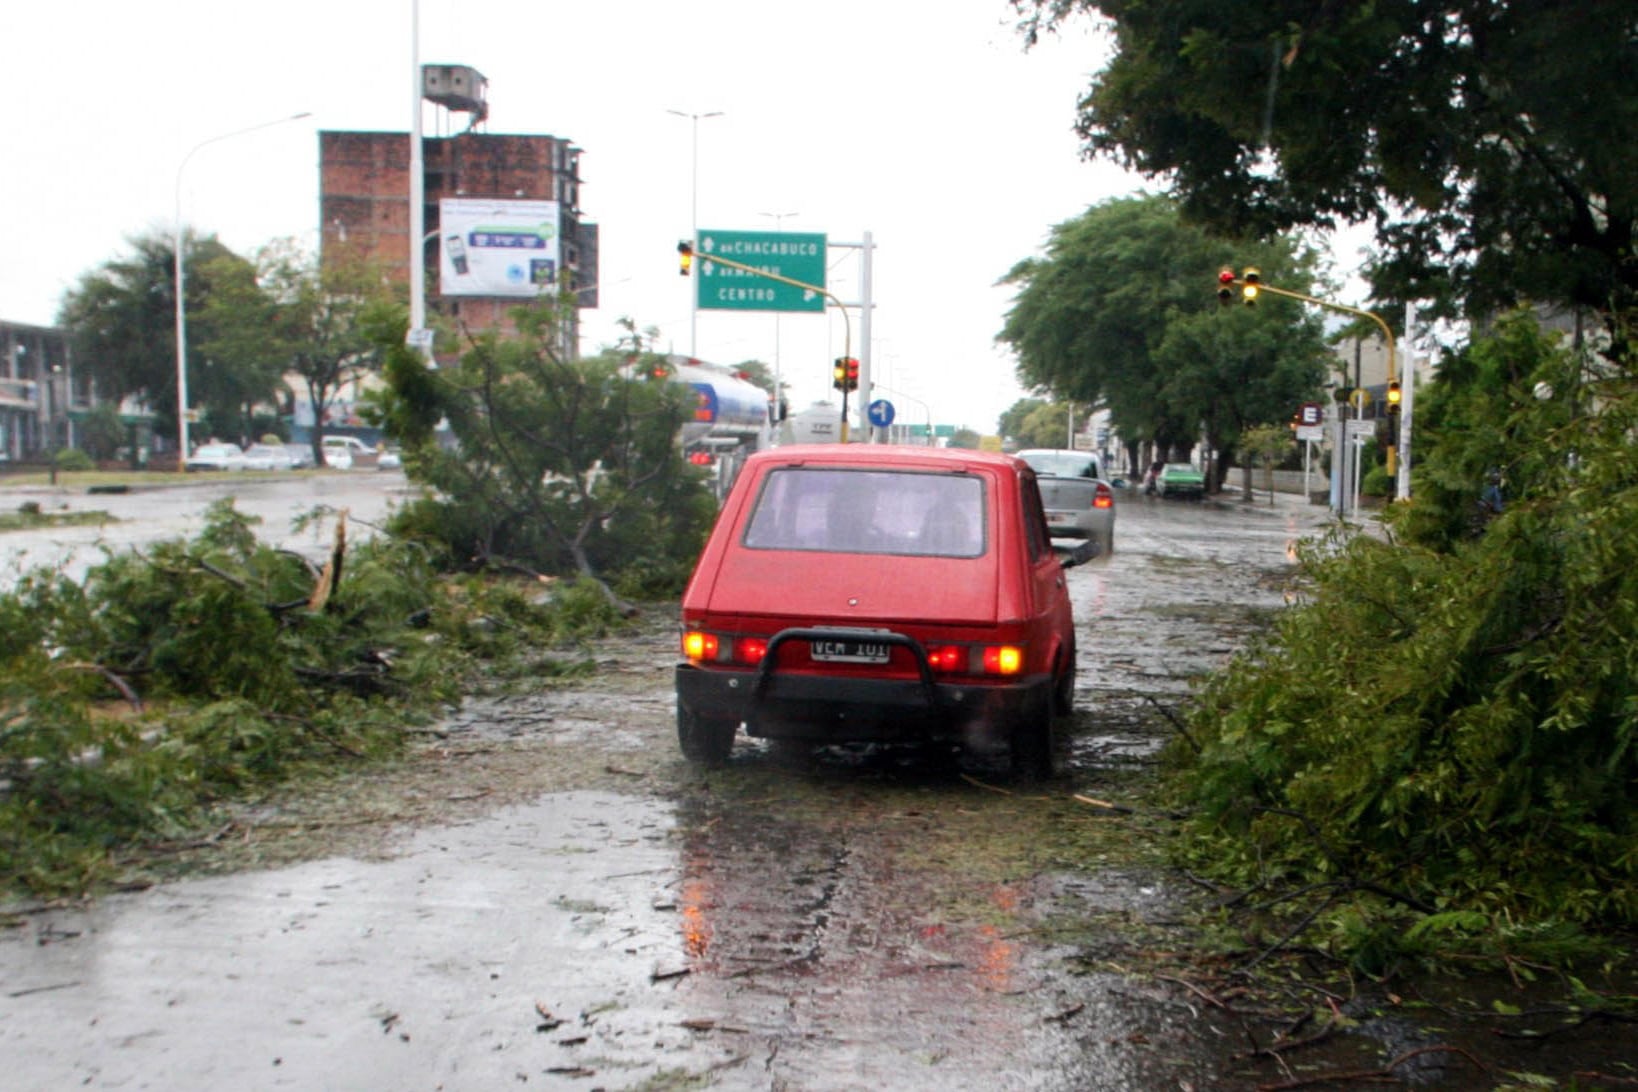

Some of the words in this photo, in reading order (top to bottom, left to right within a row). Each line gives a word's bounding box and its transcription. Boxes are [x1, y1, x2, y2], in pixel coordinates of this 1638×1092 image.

[735, 242, 817, 255] CHACABUCO
[718, 288, 776, 302] CENTRO
[1303, 407, 1317, 422] E
